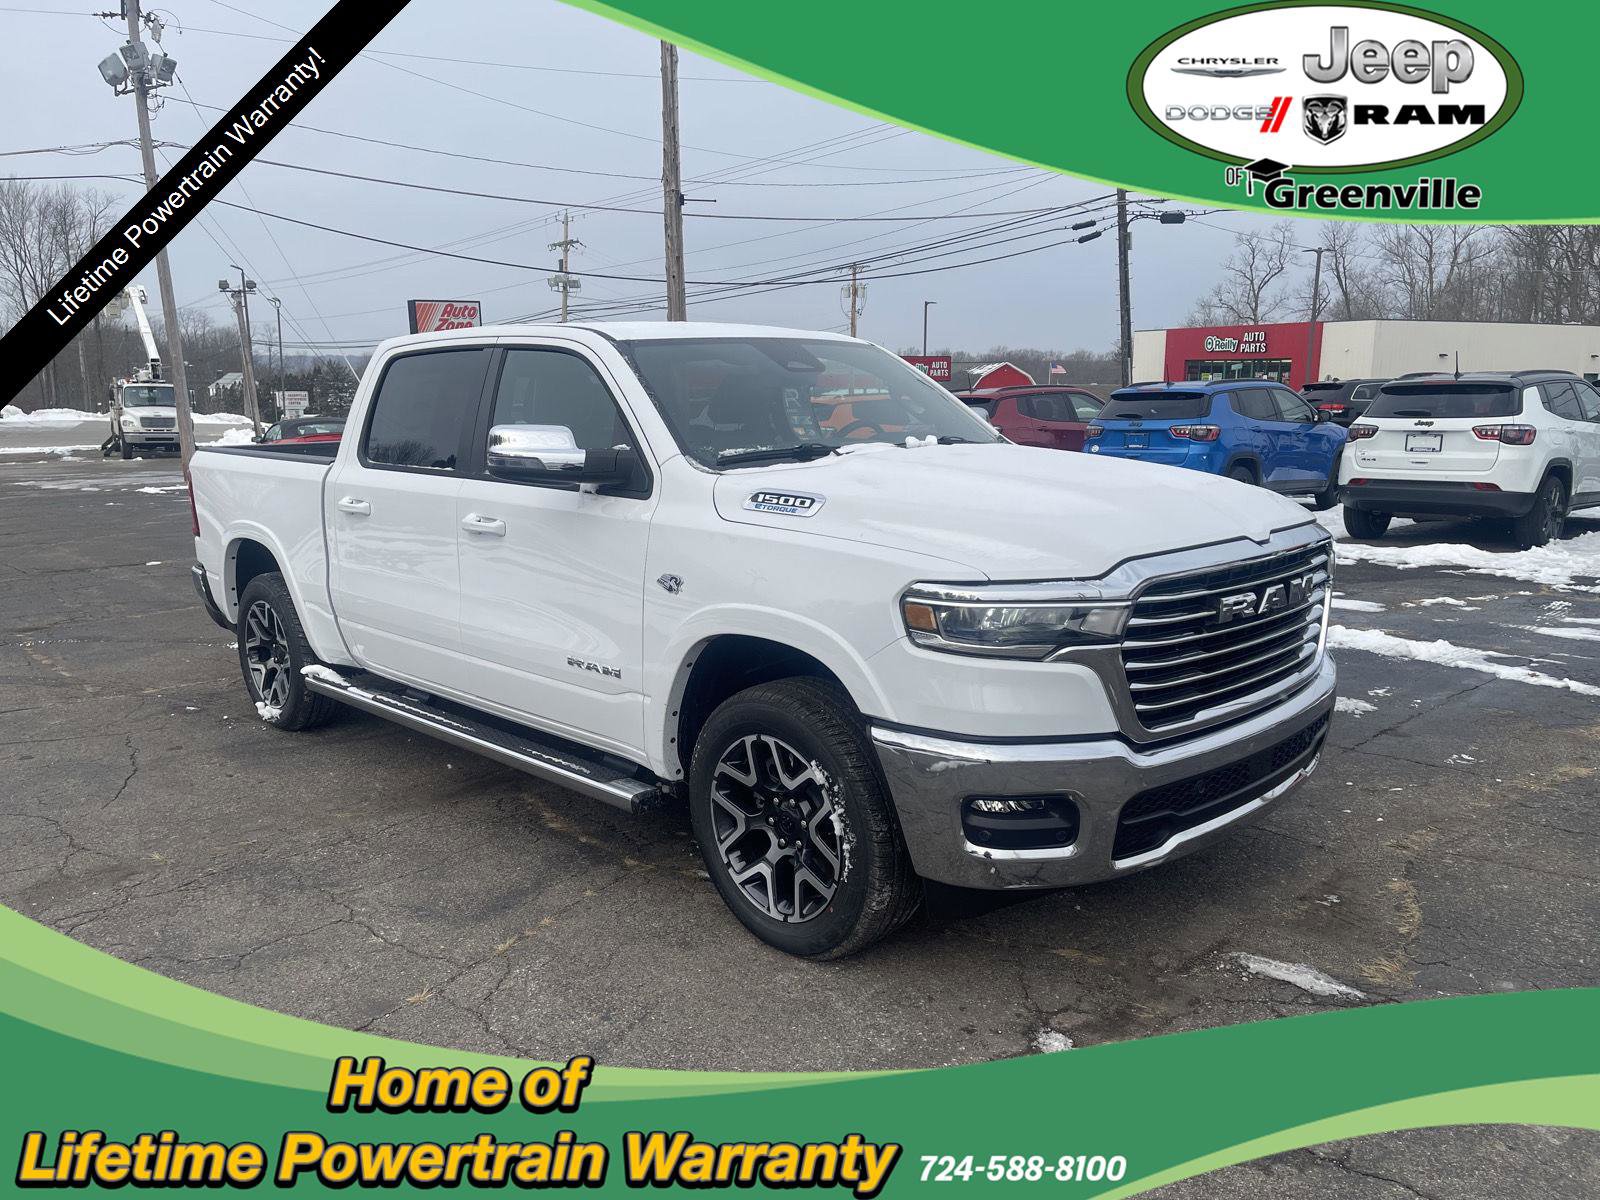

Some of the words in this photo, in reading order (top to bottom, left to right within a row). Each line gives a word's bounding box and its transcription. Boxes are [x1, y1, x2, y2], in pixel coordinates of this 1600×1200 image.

[440, 303, 478, 319] Auto
[1205, 335, 1238, 353] O'Reilly
[1243, 331, 1265, 342] AUTO
[1240, 342, 1267, 353] PARTS
[931, 361, 948, 369] AUTO
[930, 369, 949, 377] PARTS
[757, 493, 812, 508] 1500
[1219, 573, 1315, 624] RAM
[567, 656, 621, 679] RAM
